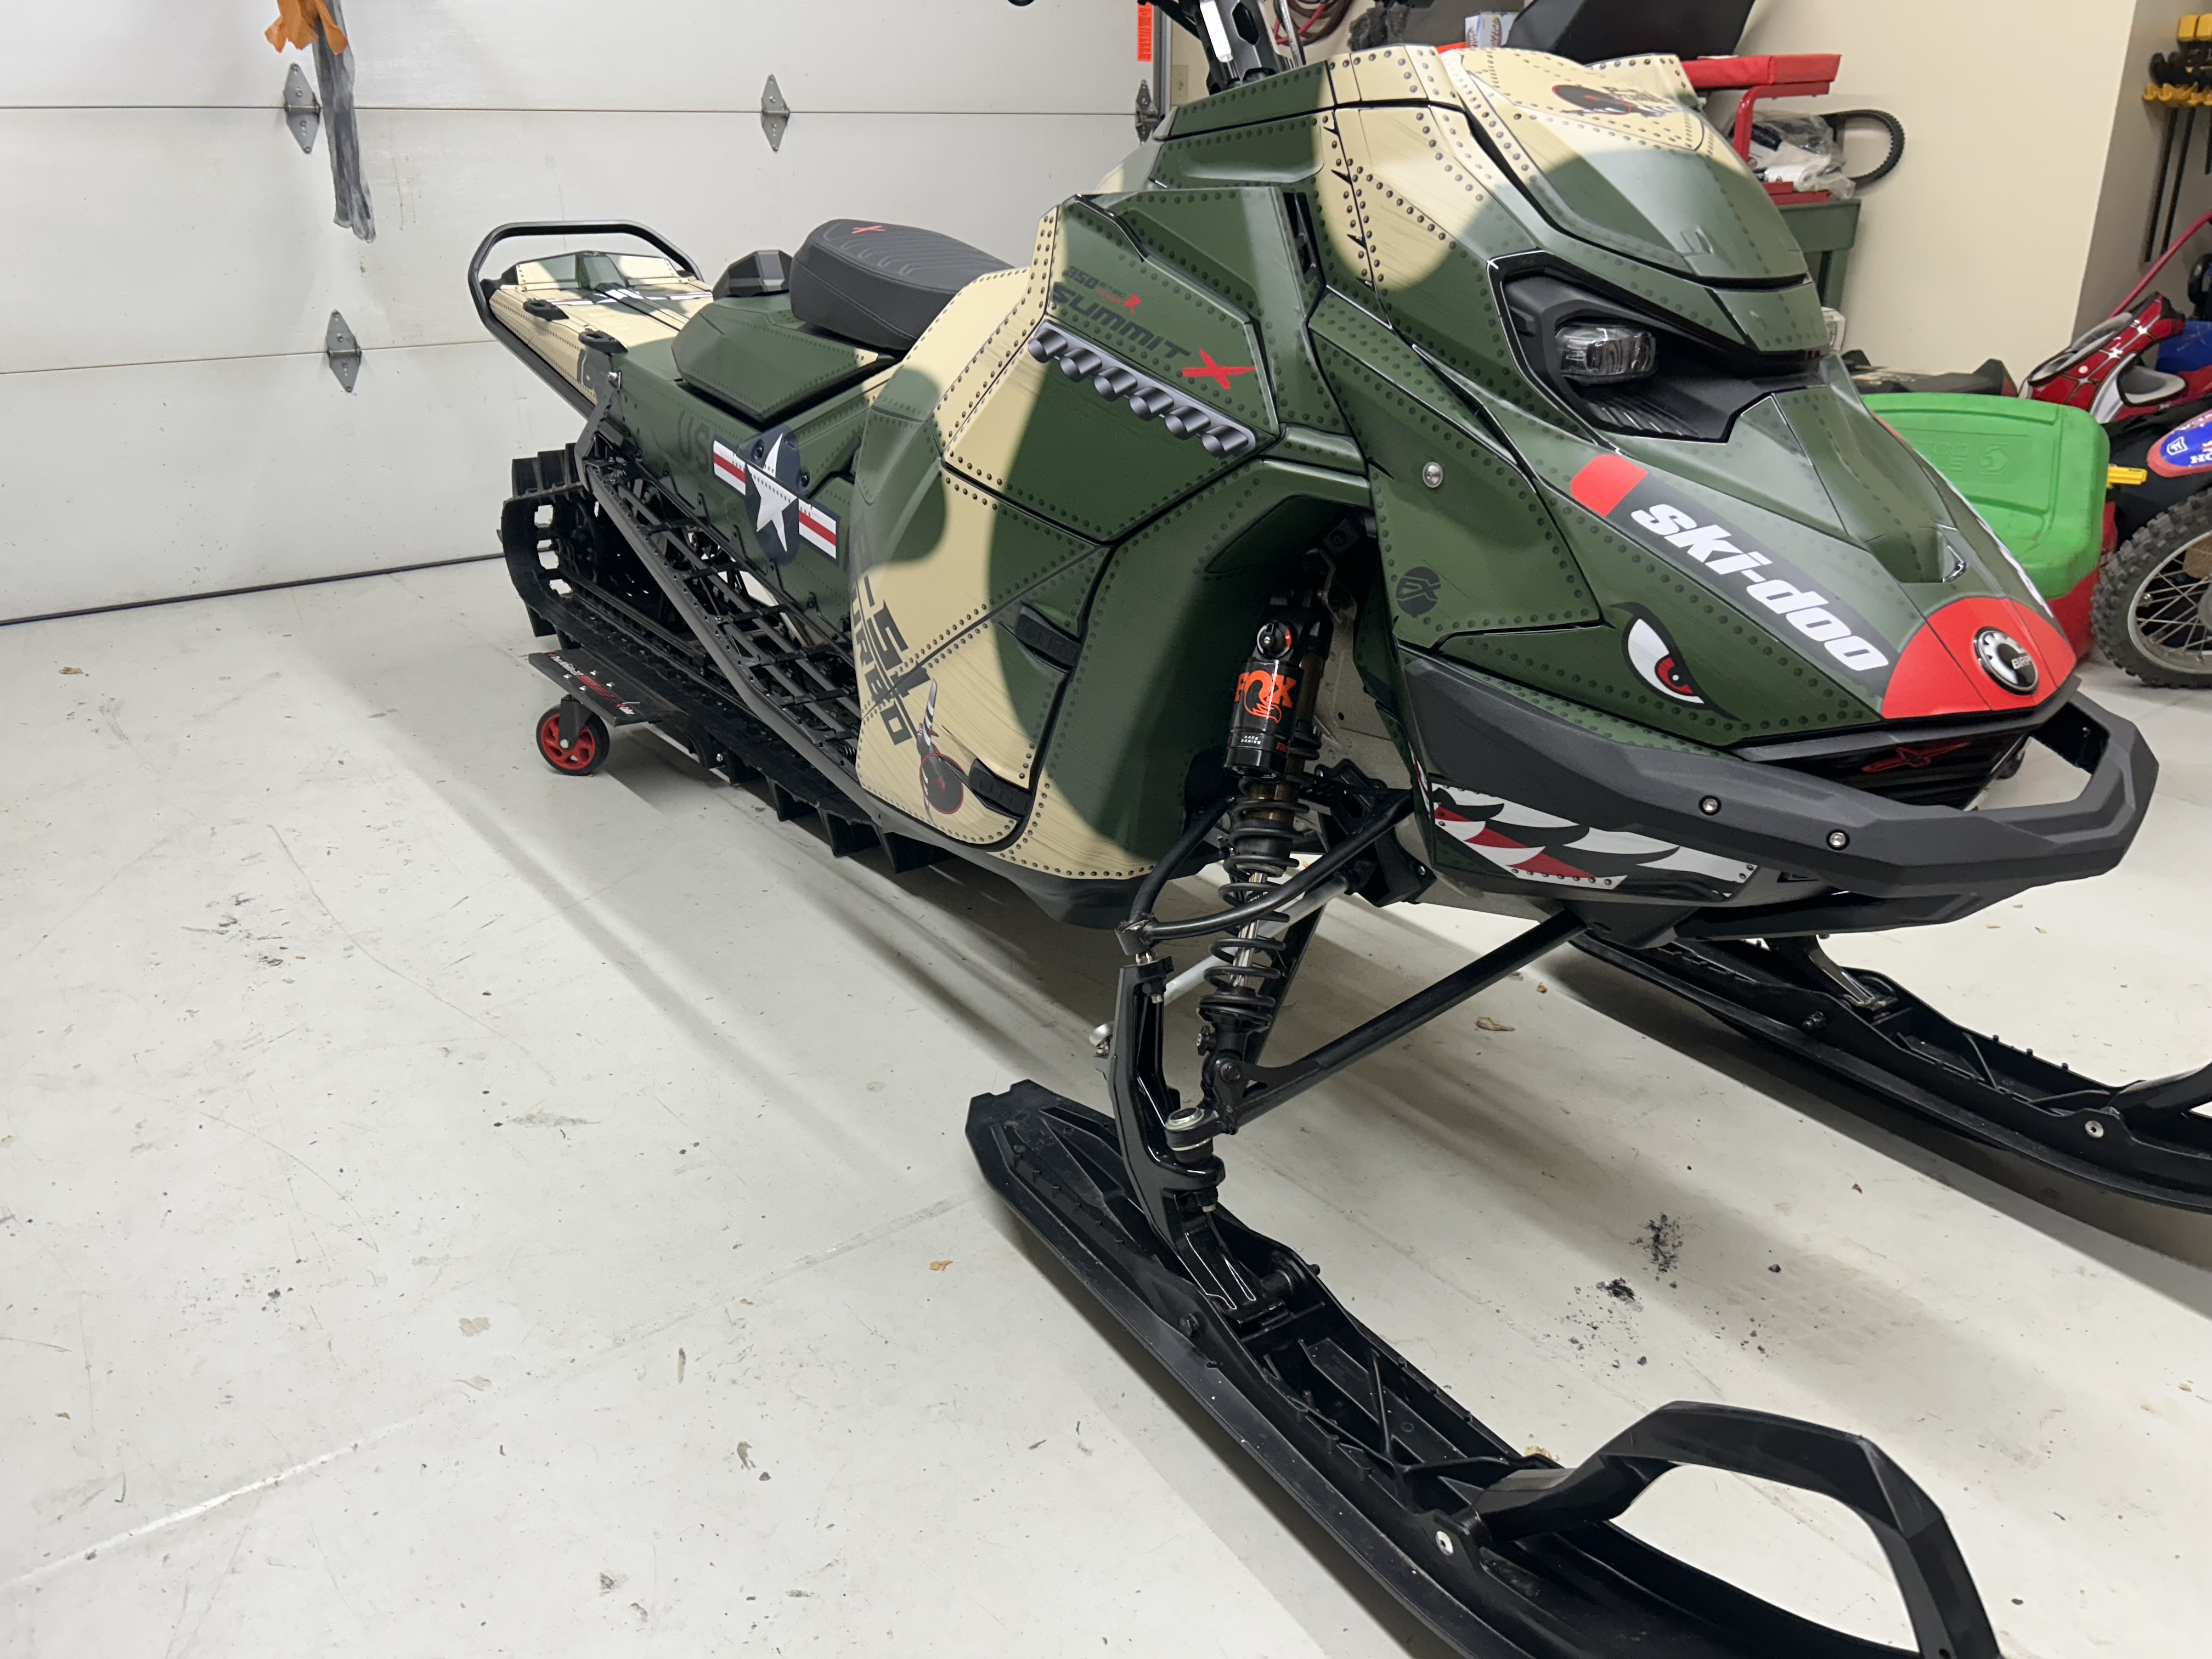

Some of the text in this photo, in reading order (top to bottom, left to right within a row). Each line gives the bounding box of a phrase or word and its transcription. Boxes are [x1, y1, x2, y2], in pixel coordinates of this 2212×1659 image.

[1062, 266, 1099, 290] 850
[1052, 281, 1257, 390] SUMMIT X
[678, 410, 709, 474] US
[1631, 504, 1889, 672] ski-doo
[850, 571, 913, 746] URBO
[2011, 655, 2031, 670] BRP
[1235, 670, 1297, 724] FOX
